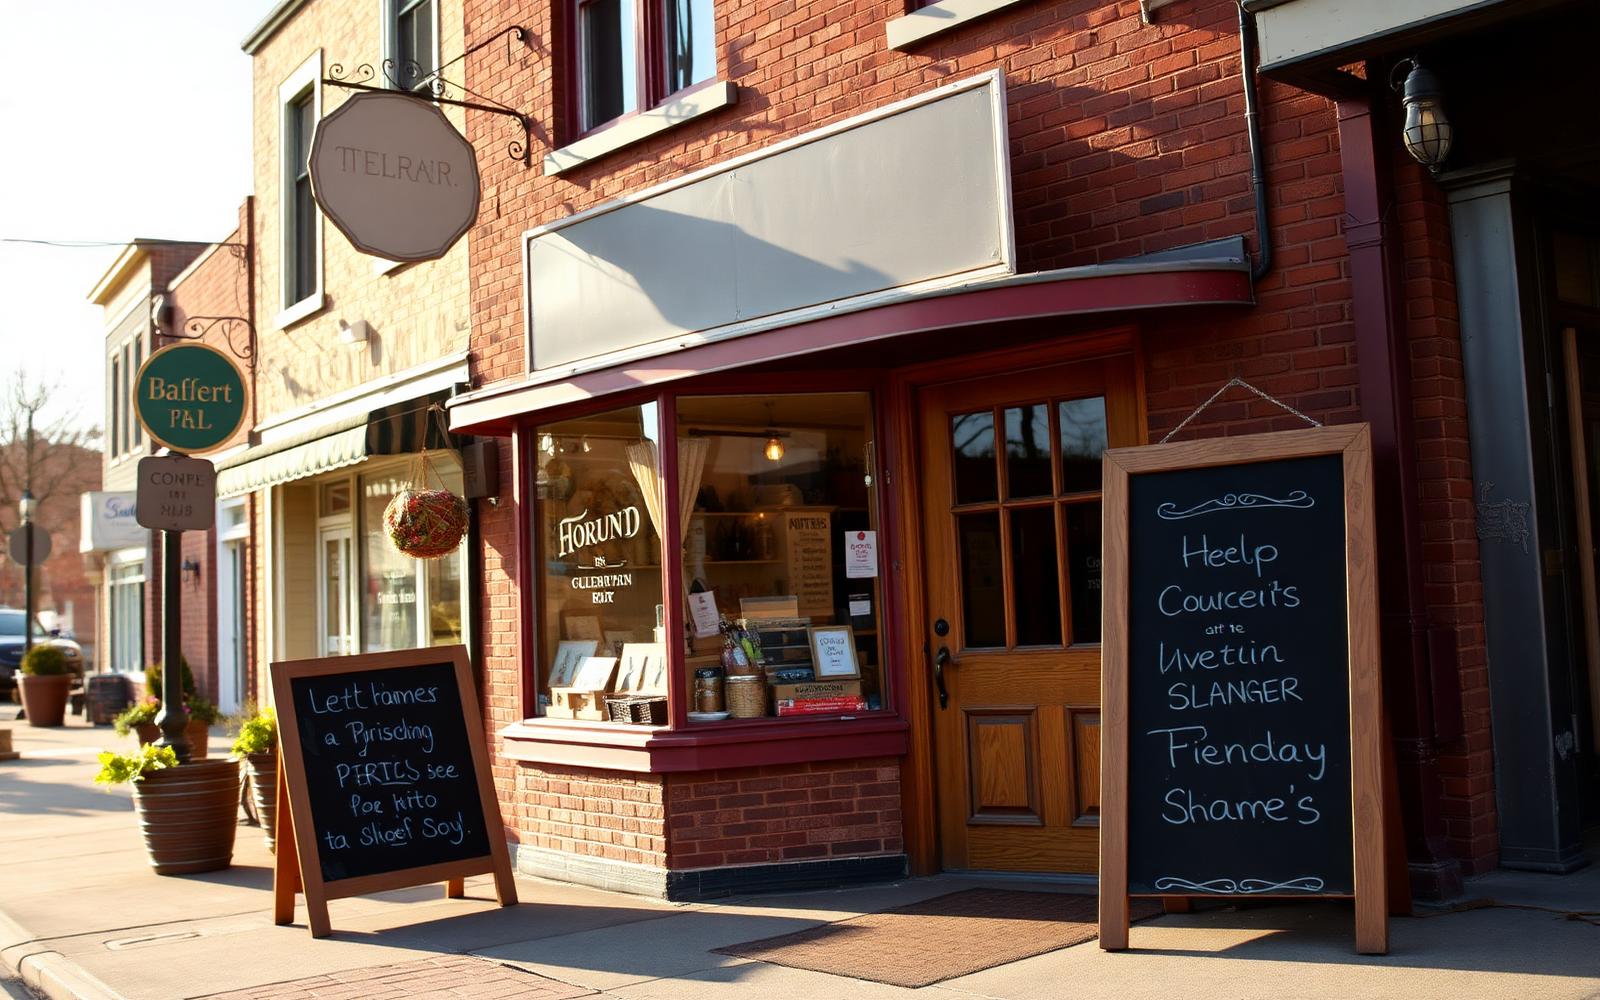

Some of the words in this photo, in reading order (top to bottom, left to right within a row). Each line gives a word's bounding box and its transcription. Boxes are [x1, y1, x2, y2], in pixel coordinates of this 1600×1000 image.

[169, 408, 213, 430] PAL
[558, 506, 640, 558] HORUND
[1168, 677, 1304, 711] SLANGER
[1161, 784, 1321, 825] Shame's
